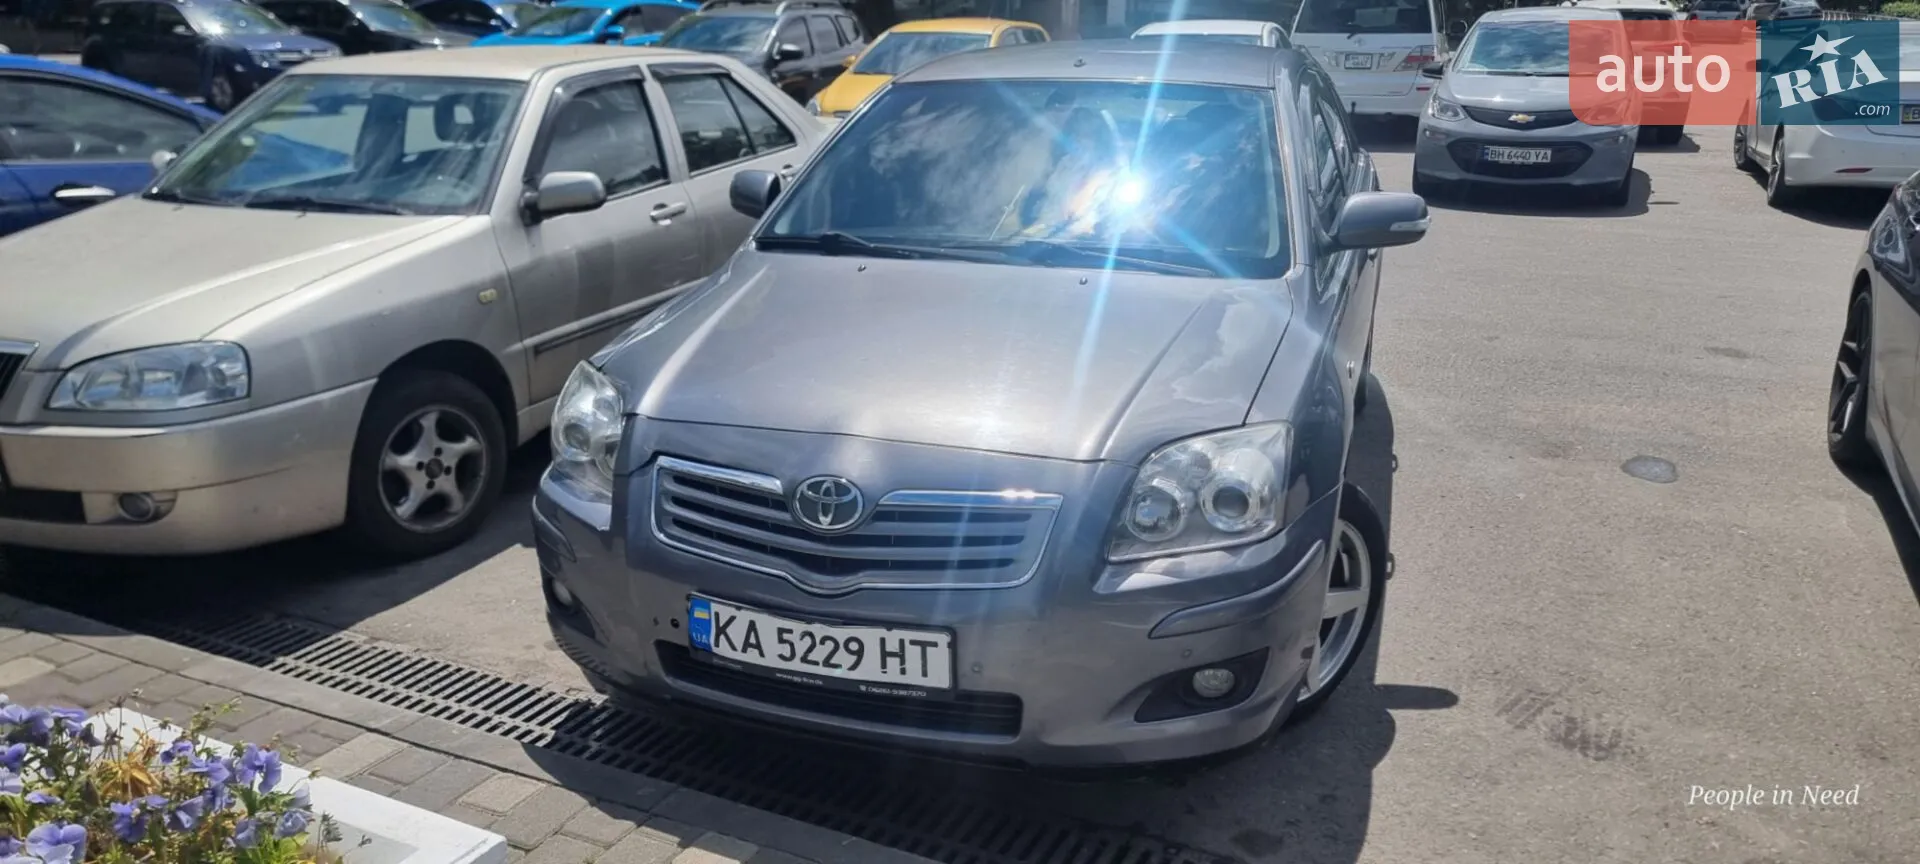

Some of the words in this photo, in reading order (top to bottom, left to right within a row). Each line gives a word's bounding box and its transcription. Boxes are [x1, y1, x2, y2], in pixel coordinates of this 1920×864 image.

[1490, 149, 1505, 160] BH
[1507, 150, 1531, 161] 6440
[1535, 151, 1549, 161] YA
[714, 611, 766, 659] KA
[777, 627, 865, 672] 5229
[880, 637, 939, 678] HT
